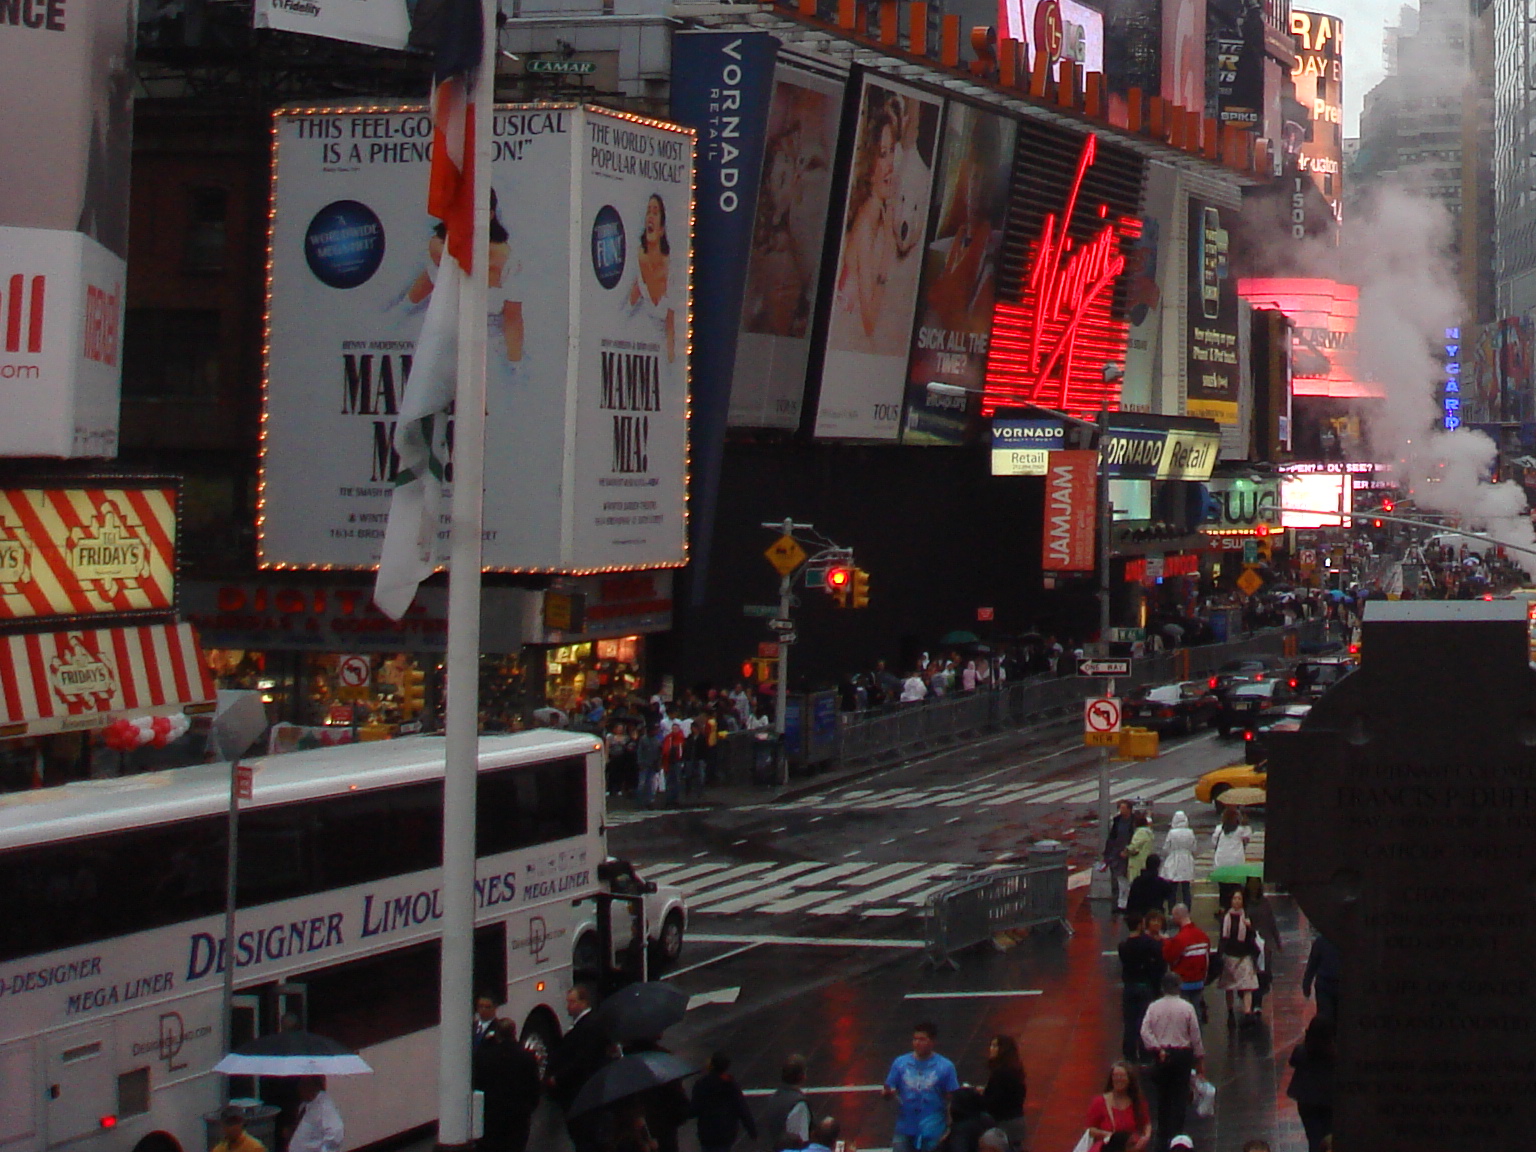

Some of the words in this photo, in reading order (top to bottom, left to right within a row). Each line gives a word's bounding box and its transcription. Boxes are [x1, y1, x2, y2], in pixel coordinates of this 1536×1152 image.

[284, 0, 321, 17] Fidelity
[531, 60, 593, 74] LAMAR
[708, 87, 720, 162] RETAIL
[719, 36, 742, 214] VORNADO
[323, 144, 341, 164] IS
[350, 143, 362, 164] A
[591, 147, 636, 176] POPULAR
[658, 141, 683, 161] MOST
[918, 326, 946, 349] SICK
[947, 331, 966, 352] ALL
[969, 332, 988, 354] THE
[936, 352, 967, 375] TIME?
[600, 351, 661, 412] MAMMA
[874, 404, 899, 422] TOUS
[611, 415, 648, 473] MIA!
[993, 428, 1064, 438] VORNADO
[1011, 452, 1044, 464] Retail
[1170, 441, 1211, 470] Retail
[1049, 465, 1074, 566] JAMJAM
[1106, 663, 1123, 672] WAY
[524, 883, 555, 902] MEGA
[558, 870, 590, 893] LINER
[187, 912, 343, 981] DESIGNER
[67, 985, 119, 1015] MEGA
[125, 971, 174, 1001] LINER
